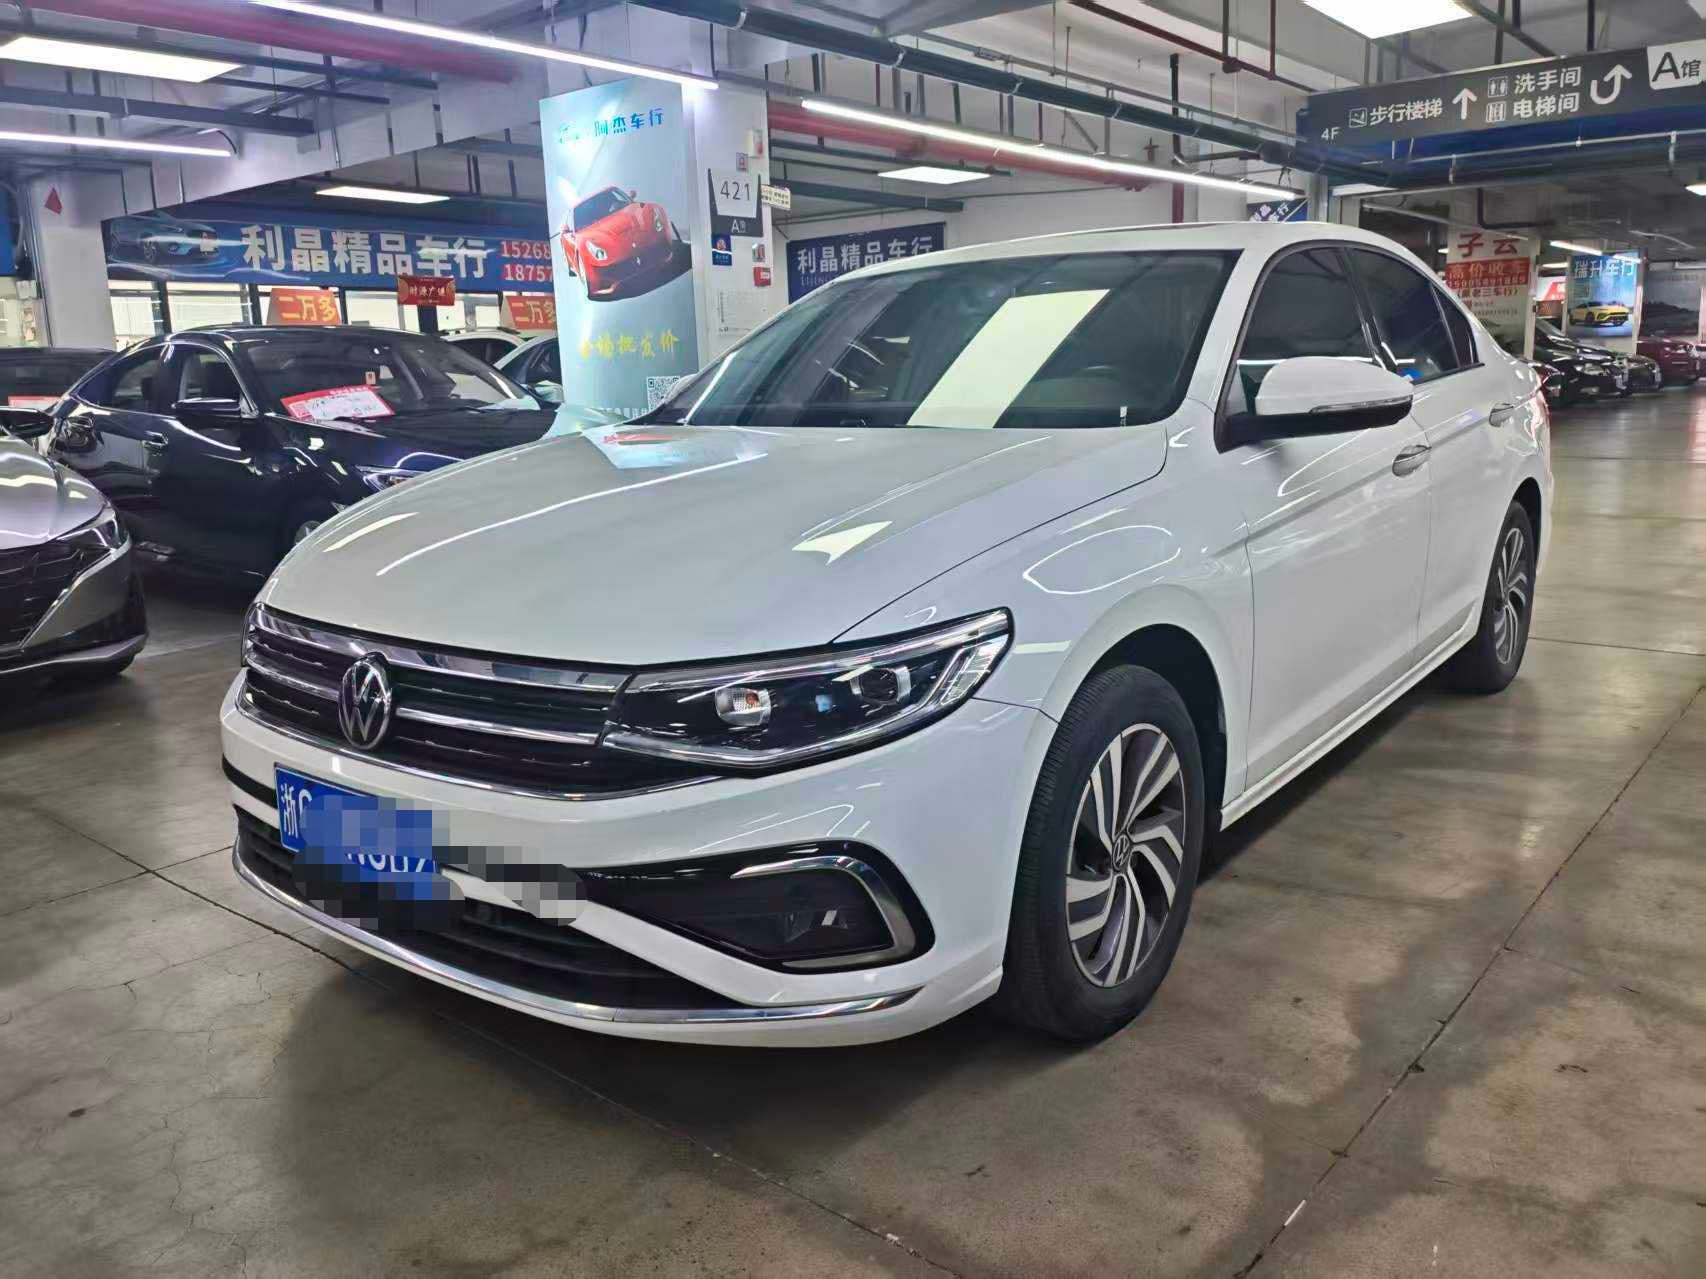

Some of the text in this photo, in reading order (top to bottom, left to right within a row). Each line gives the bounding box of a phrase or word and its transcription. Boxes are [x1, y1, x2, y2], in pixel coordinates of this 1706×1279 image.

[1514, 66, 1582, 94] 洗手间
[1652, 52, 1701, 82] A馆
[1370, 98, 1443, 126] 步行楼梯
[1513, 92, 1580, 119] 电梯间
[1321, 127, 1340, 141] 4F
[720, 181, 750, 201] 421
[240, 224, 488, 278] 利晶精品车行
[501, 241, 551, 260] 15268
[798, 236, 932, 274] 利晶精品车行
[1457, 232, 1518, 258] 子云
[278, 296, 337, 321] 二万多
